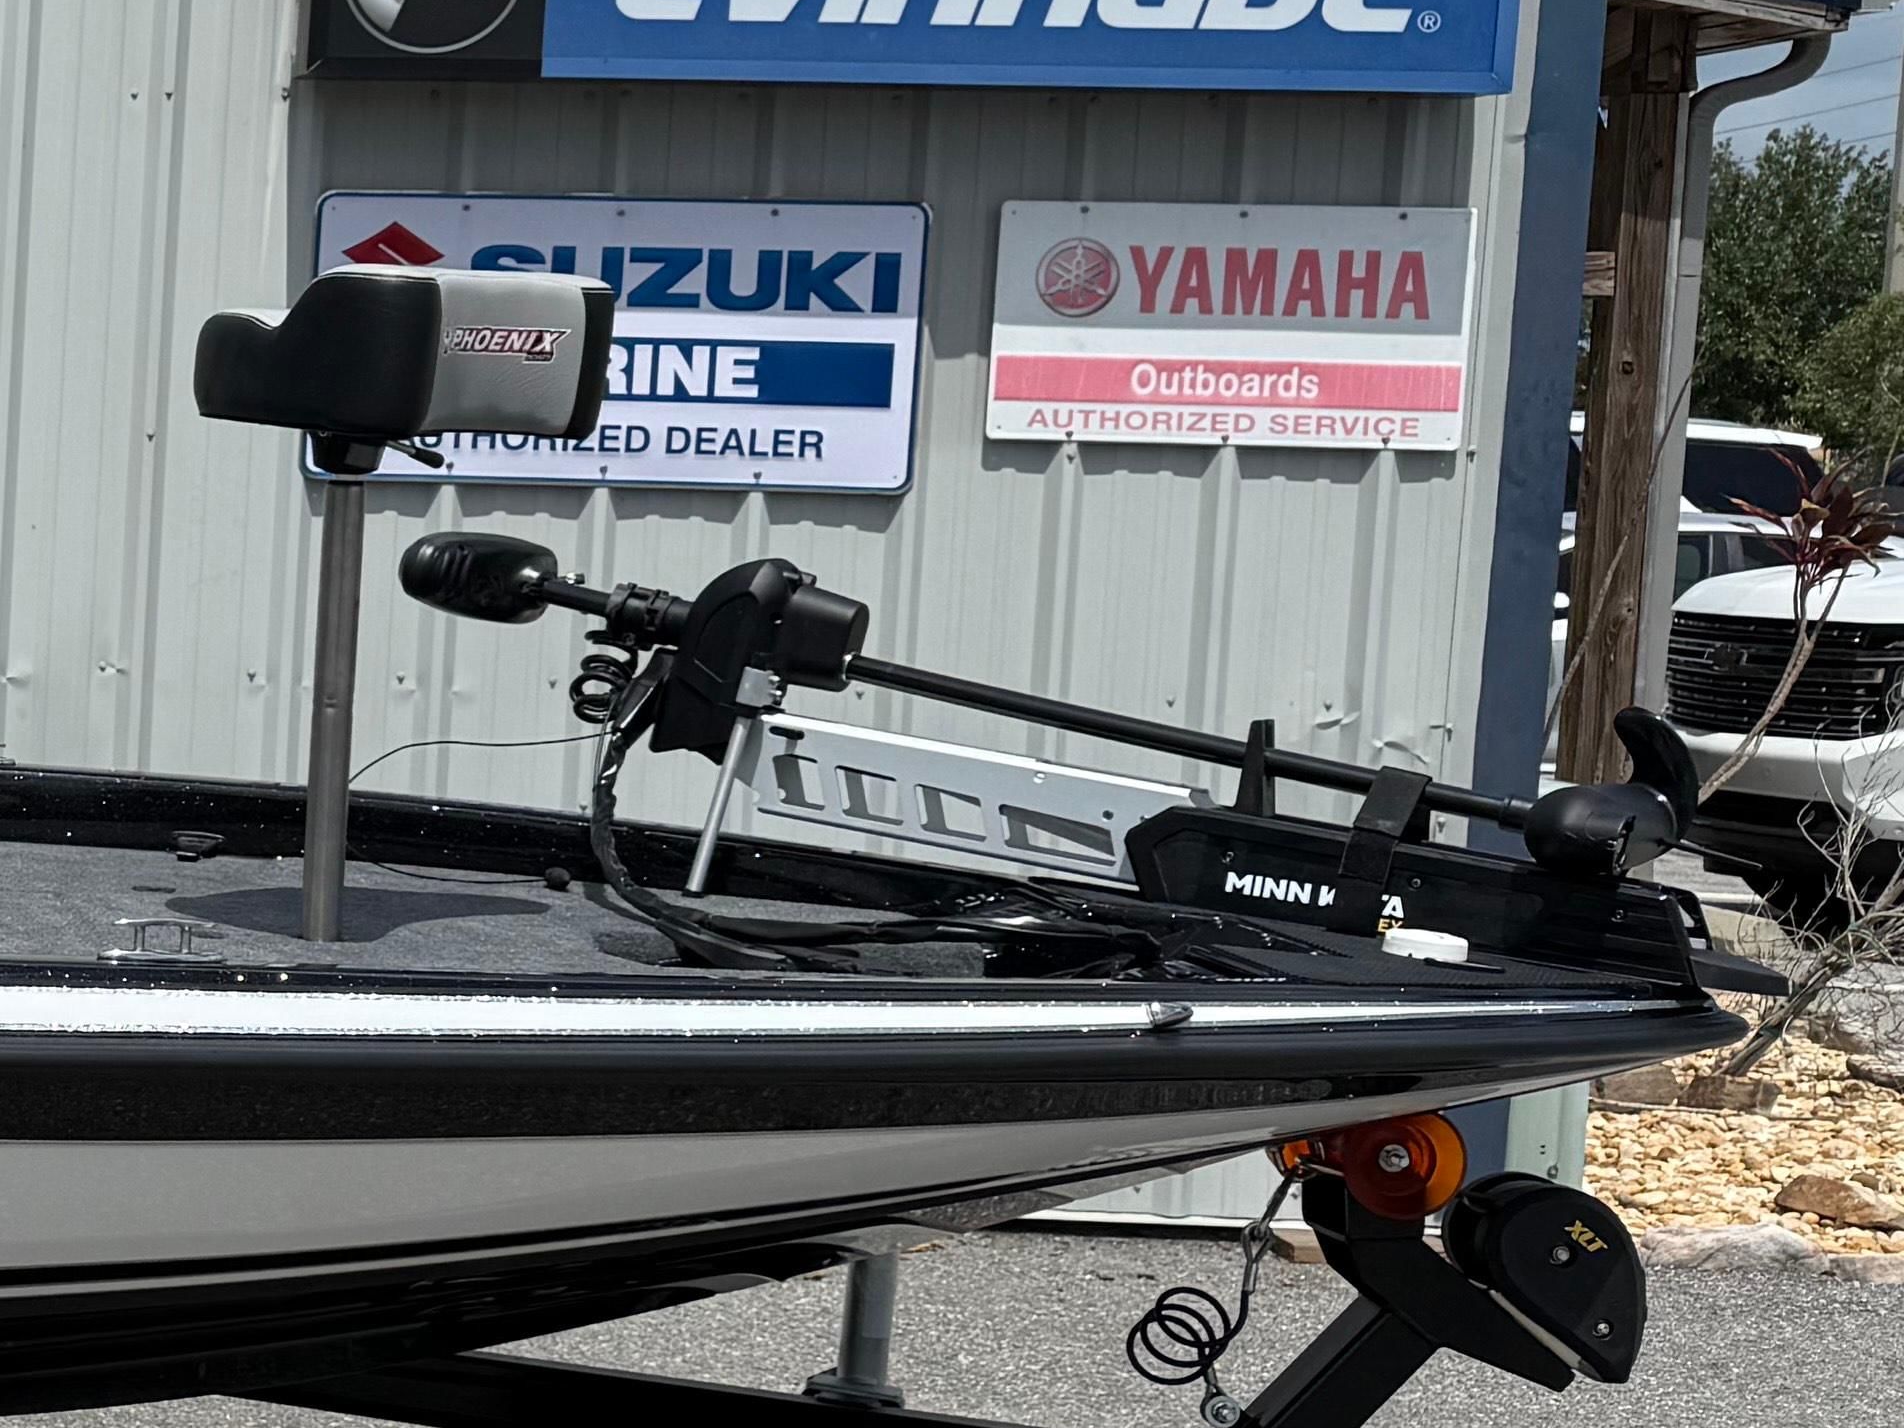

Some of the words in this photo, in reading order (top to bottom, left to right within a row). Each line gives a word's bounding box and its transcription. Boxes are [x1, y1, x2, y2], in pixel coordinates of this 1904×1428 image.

[1129, 245, 1430, 321] YAMAHA
[450, 328, 562, 354] PHOENIX
[1130, 362, 1320, 399] Outboards
[1027, 408, 1256, 434] AUTHORIZED
[1268, 415, 1421, 438] SERVICE
[664, 426, 825, 460] DEALER
[1224, 871, 1312, 905] MINN
[1564, 1219, 1609, 1253] XLT
